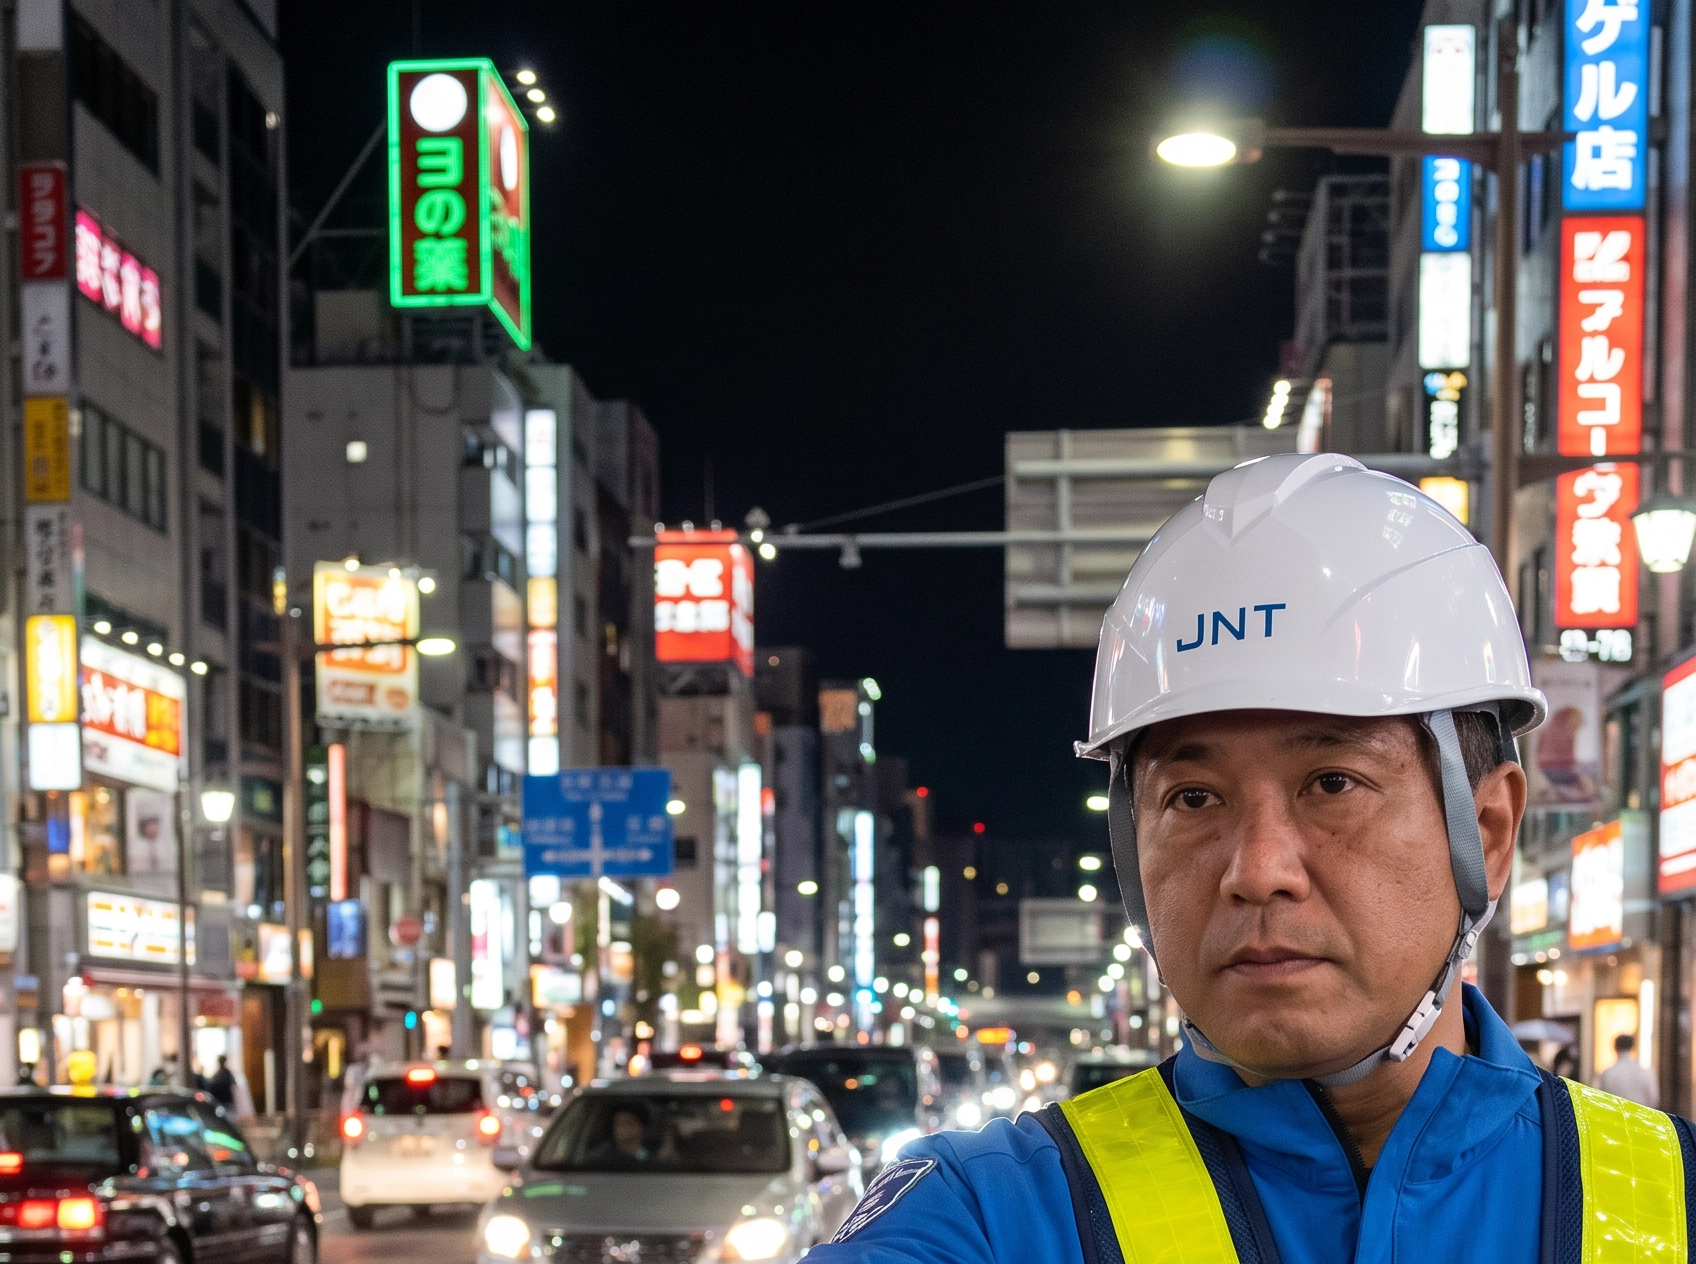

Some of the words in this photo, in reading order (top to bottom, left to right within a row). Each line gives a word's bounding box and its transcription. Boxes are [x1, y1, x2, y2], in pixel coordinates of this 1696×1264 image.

[1570, 0, 1639, 191] ゲル店
[1176, 603, 1287, 653] JNT
